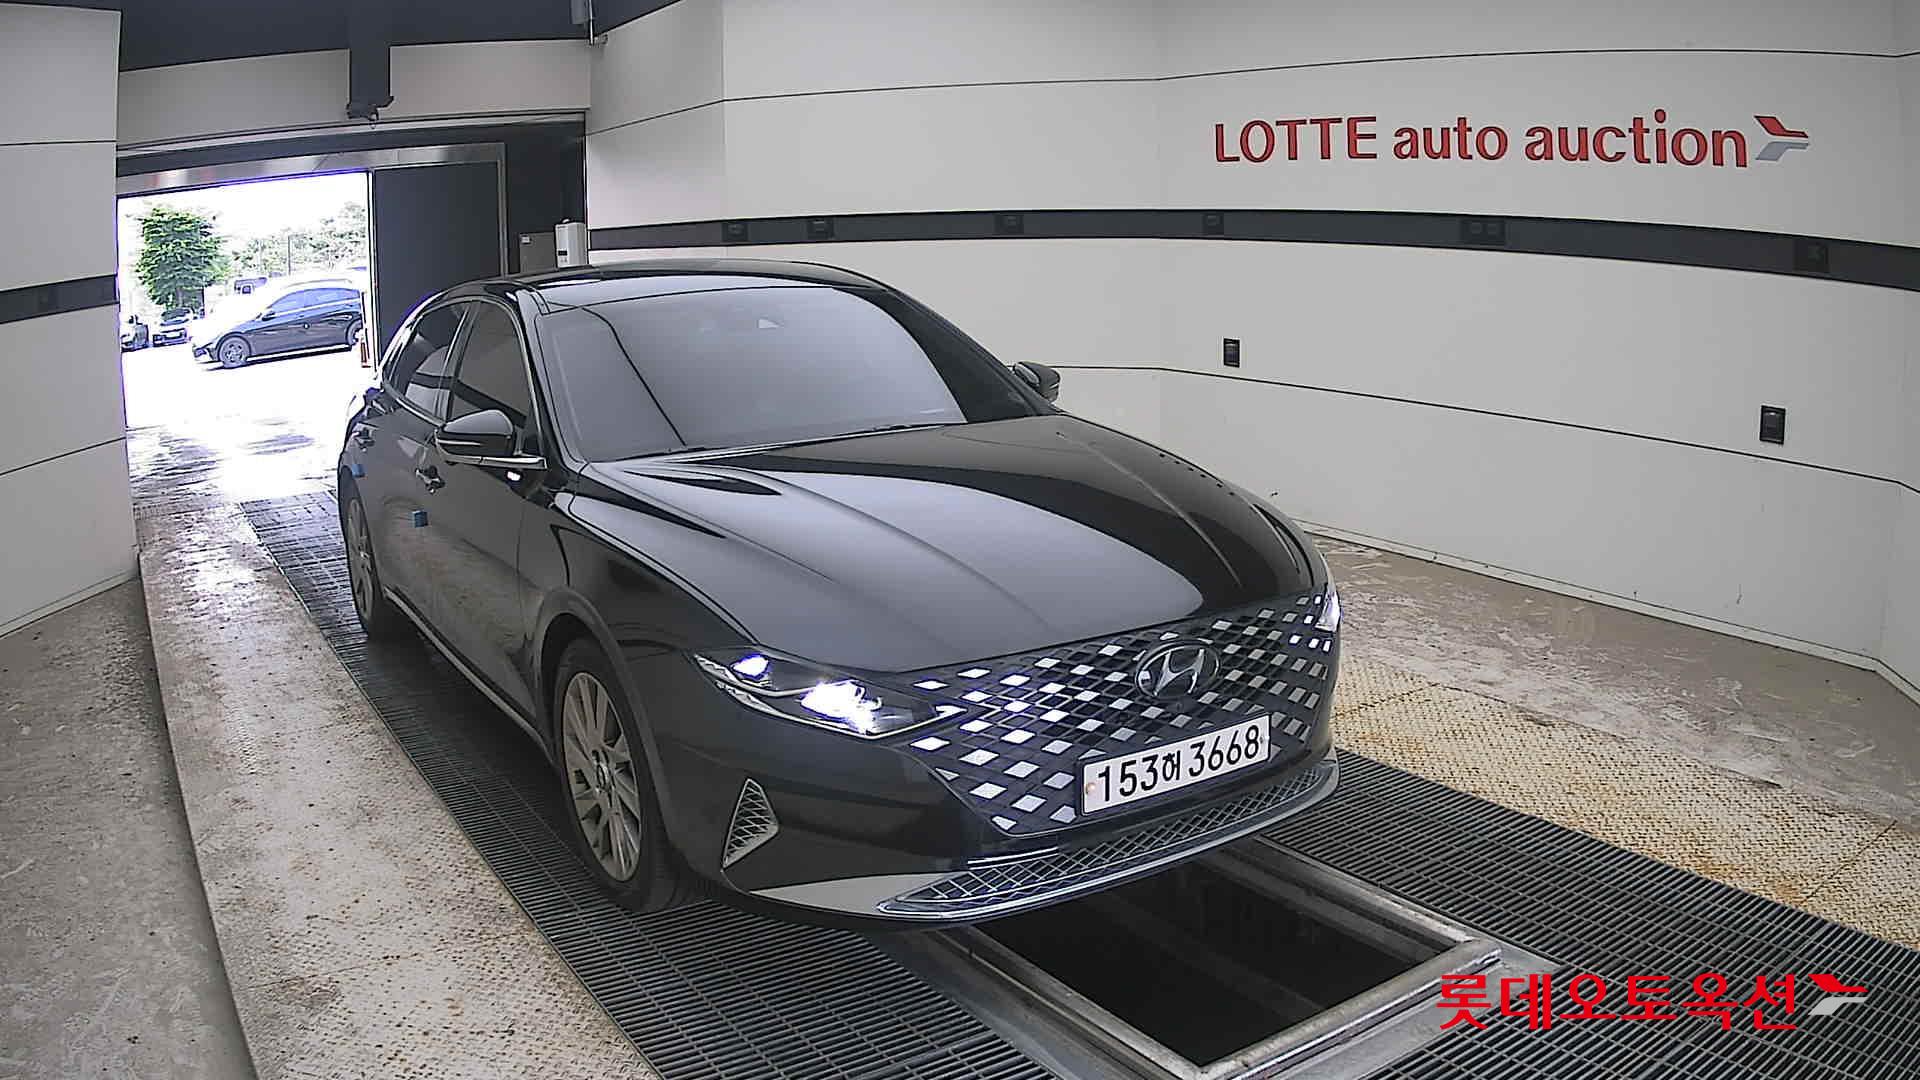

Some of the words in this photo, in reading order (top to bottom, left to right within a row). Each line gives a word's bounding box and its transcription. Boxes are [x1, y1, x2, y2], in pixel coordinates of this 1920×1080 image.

[1215, 116, 1377, 162] LOTTE
[1393, 117, 1509, 161] auto
[1524, 109, 1749, 168] auction
[1098, 751, 1181, 802] 153허
[1188, 725, 1260, 777] 3668
